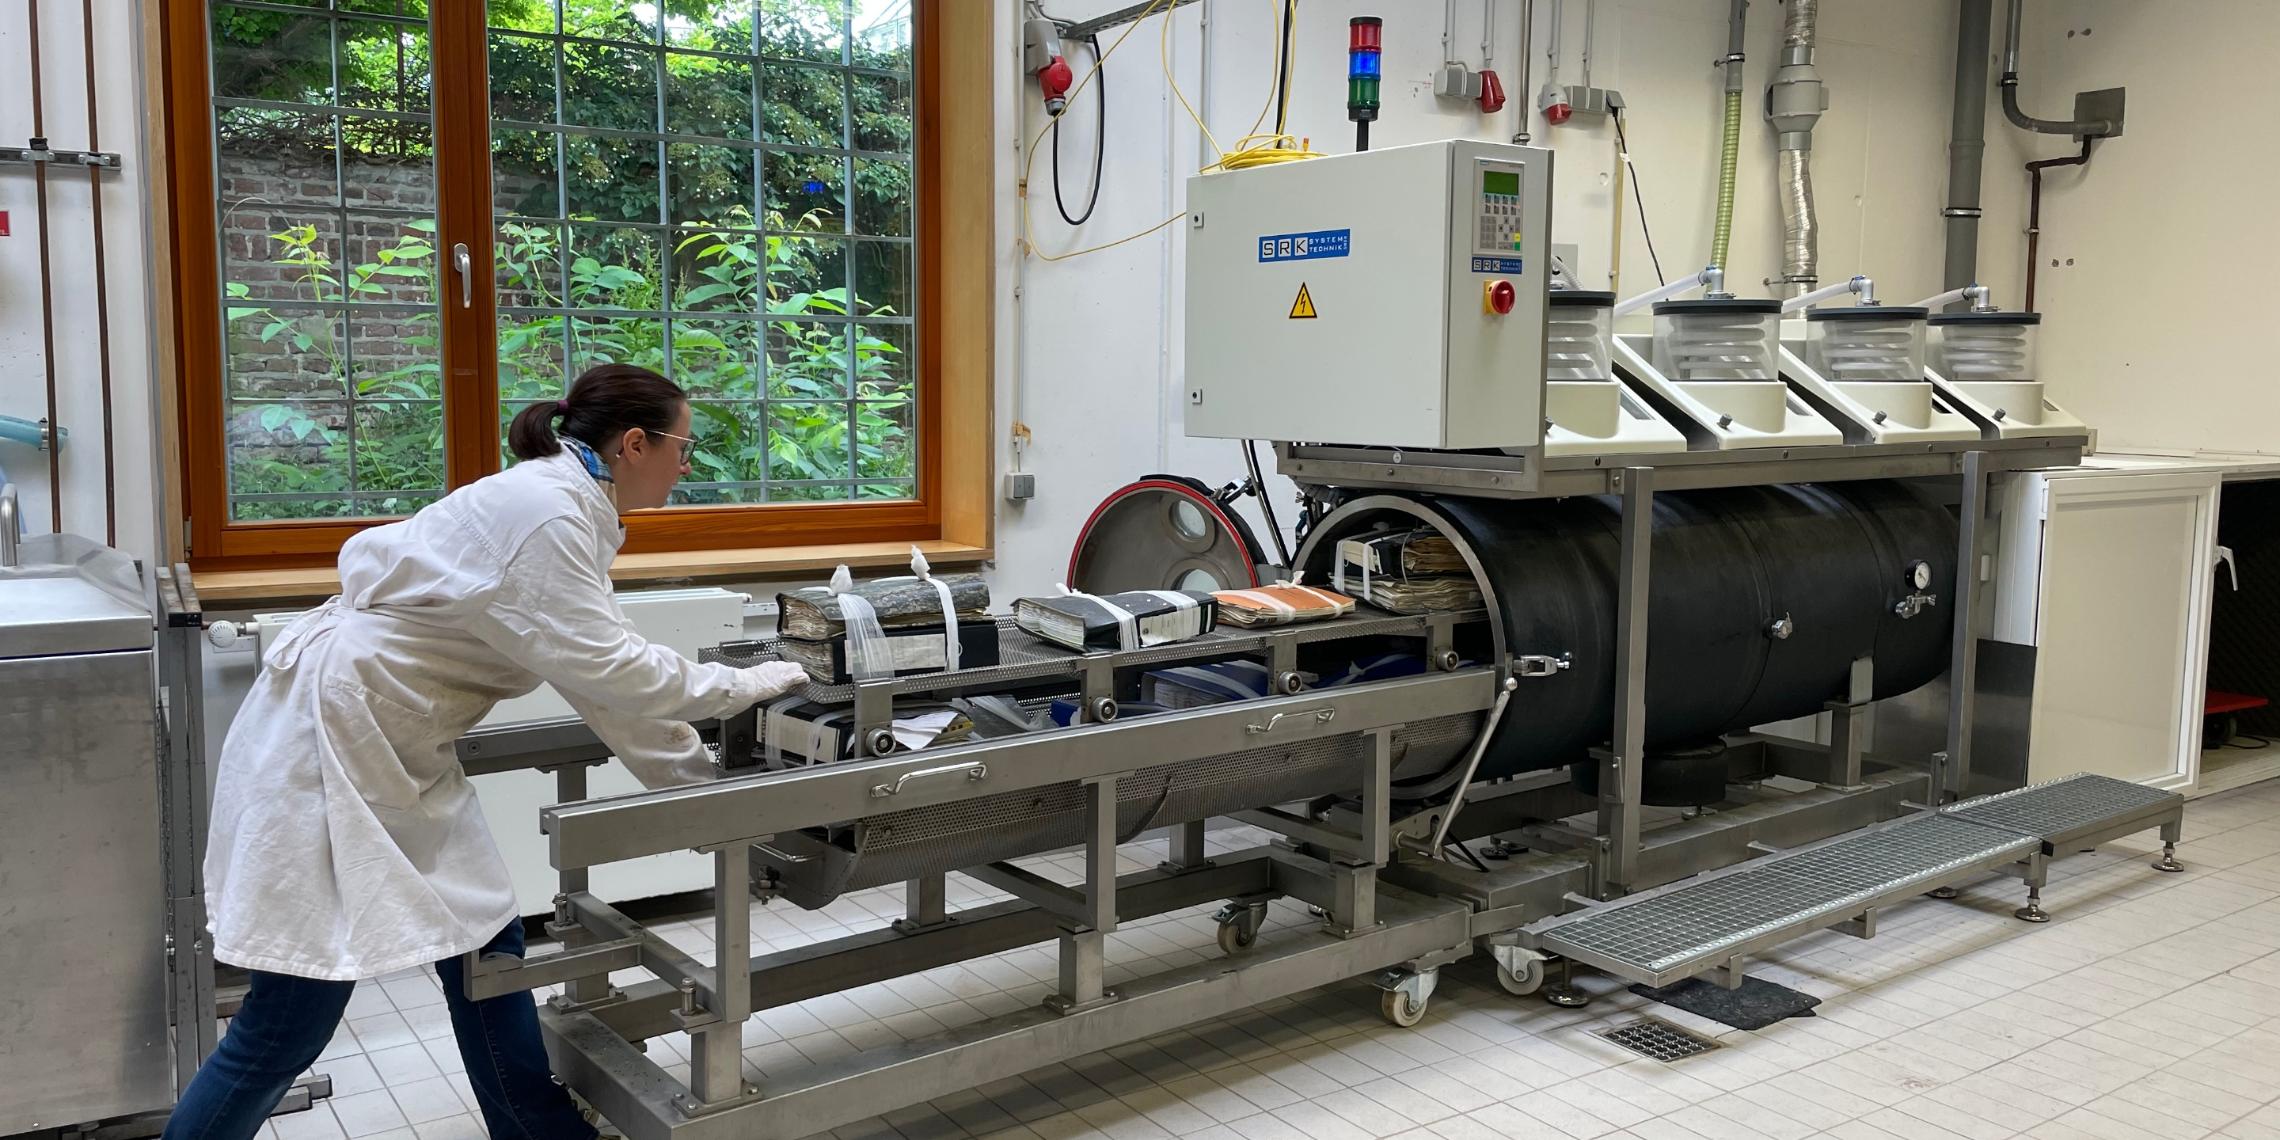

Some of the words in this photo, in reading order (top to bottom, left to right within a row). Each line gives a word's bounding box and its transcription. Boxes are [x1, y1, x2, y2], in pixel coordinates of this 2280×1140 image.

[1309, 236, 1343, 245] SYSTEM
[1263, 239, 1306, 256] SRK
[1309, 244, 1343, 253] TECHNIK
[1474, 260, 1499, 270] SRK
